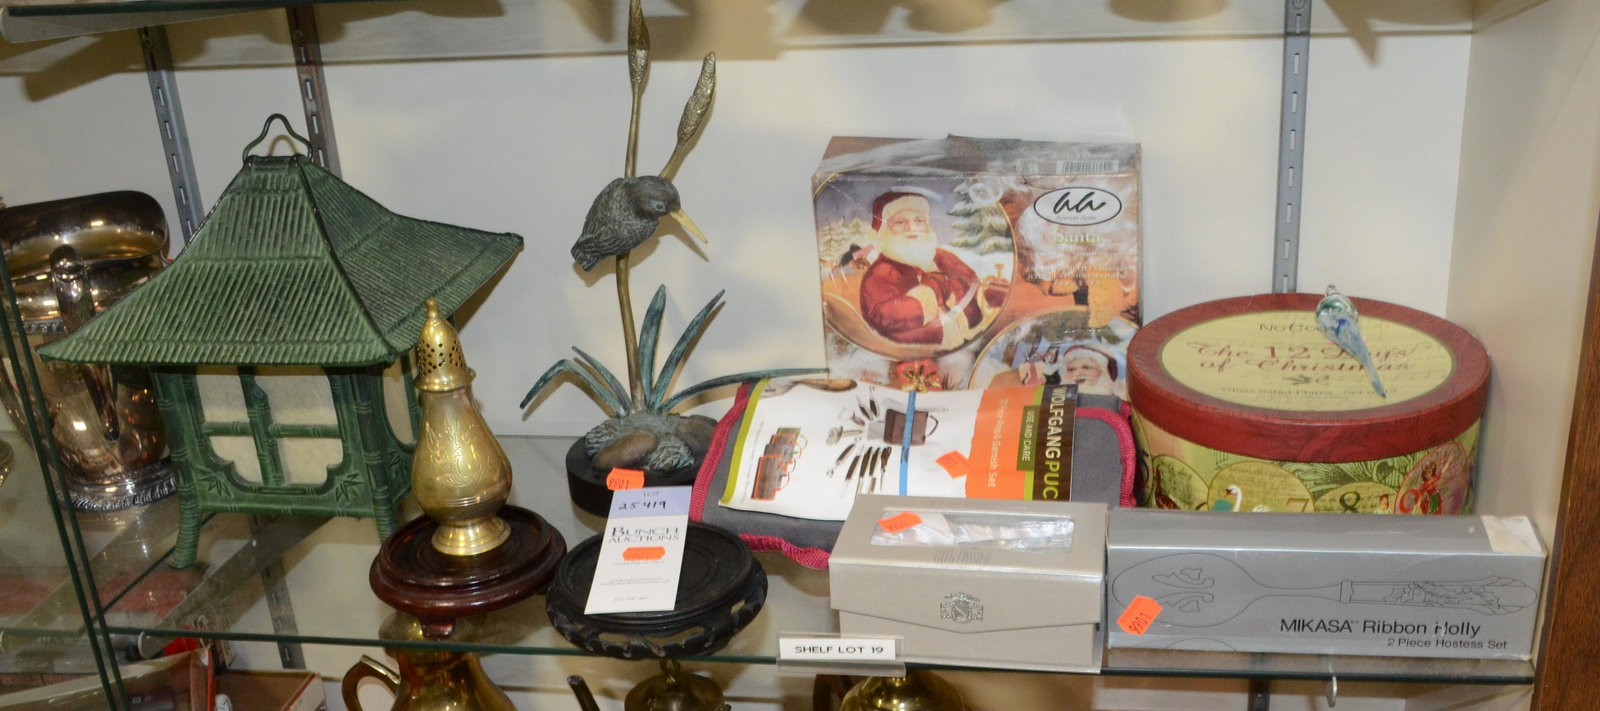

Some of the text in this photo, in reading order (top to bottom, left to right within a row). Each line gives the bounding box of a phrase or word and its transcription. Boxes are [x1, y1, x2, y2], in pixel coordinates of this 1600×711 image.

[1055, 228, 1104, 244] Santa
[1187, 342, 1408, 362] The 12 Dys
[1200, 358, 1416, 373] of Christmas
[1021, 411, 1035, 461] USE AND CARE
[1042, 386, 1067, 499] WOLFGANG PUC
[989, 441, 1001, 470] Garnish
[988, 472, 998, 488] Set
[1339, 490, 1361, 513] 8
[608, 535, 680, 543] AUCTIONS
[612, 526, 679, 537] BUNCH
[1280, 618, 1481, 640] MIKASA Ribbon Holly
[795, 646, 884, 655] SHELF LOT 19
[1387, 638, 1508, 650] 2 Piece Hostess Set
